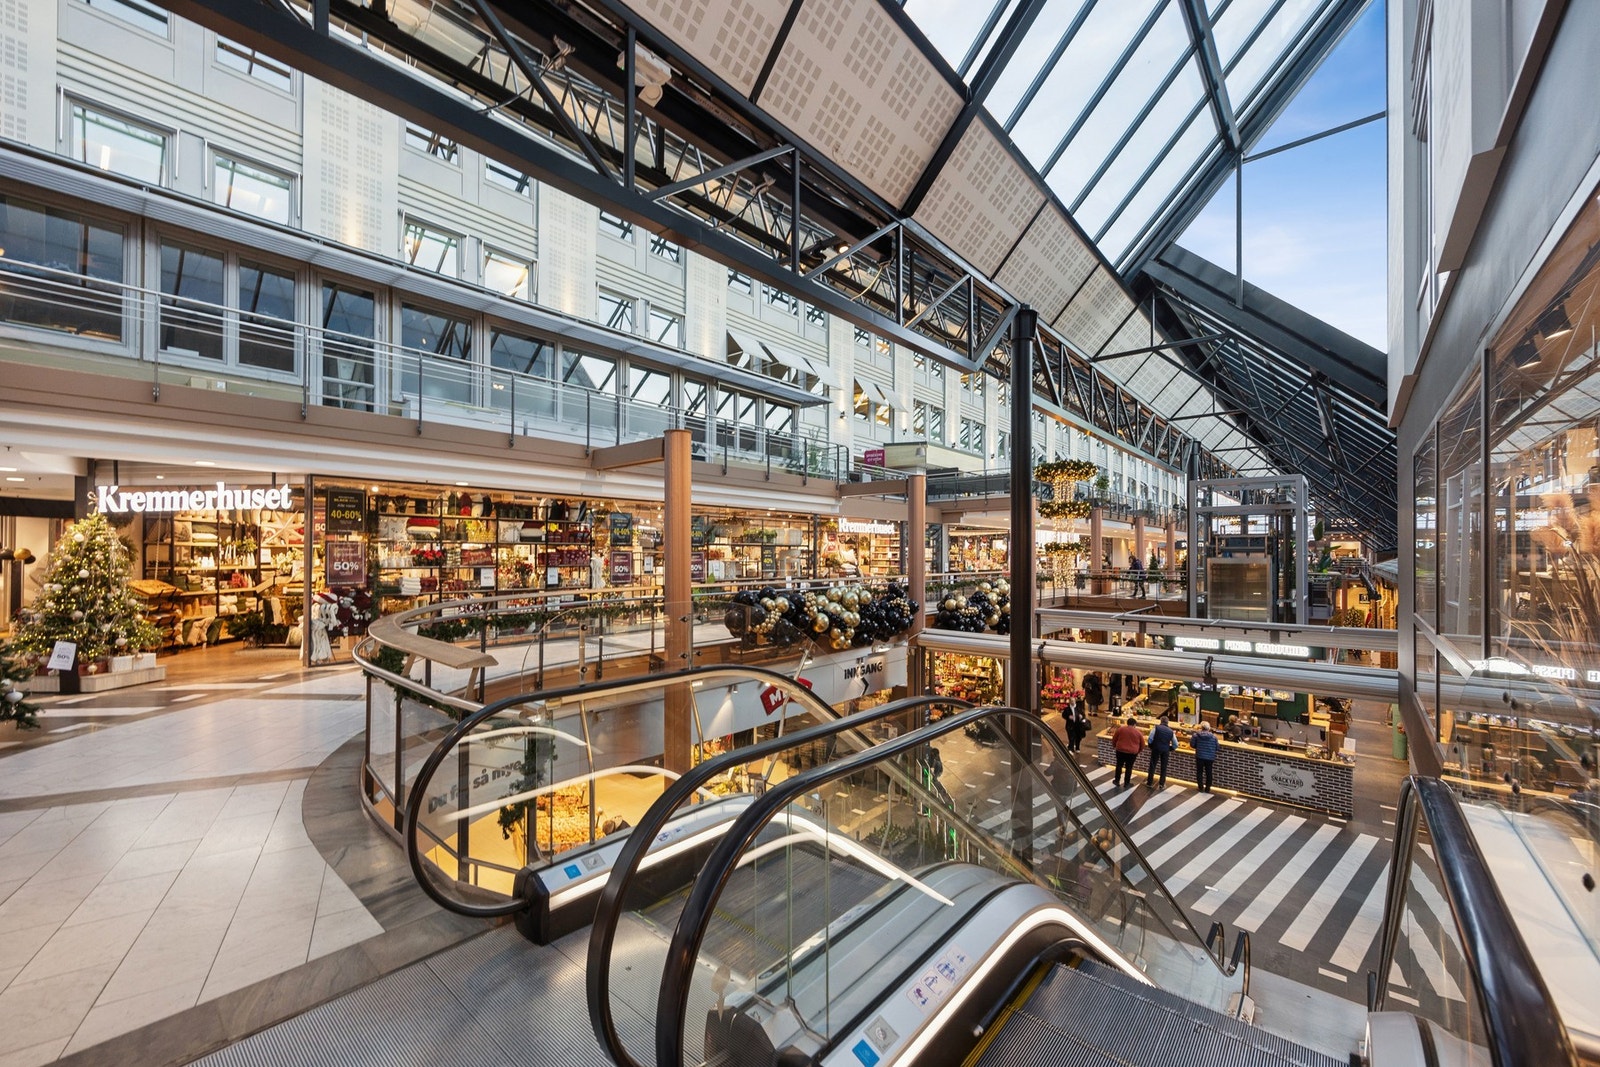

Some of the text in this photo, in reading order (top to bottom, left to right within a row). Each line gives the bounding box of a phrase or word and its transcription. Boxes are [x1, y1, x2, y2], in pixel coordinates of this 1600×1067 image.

[98, 482, 293, 513] Kremmerhuset
[331, 509, 362, 519] 40-60%
[838, 517, 895, 535] Kremmerhuset
[333, 561, 359, 571] 50%
[614, 565, 629, 573] 50%
[1270, 775, 1304, 788] SNACKYARD
